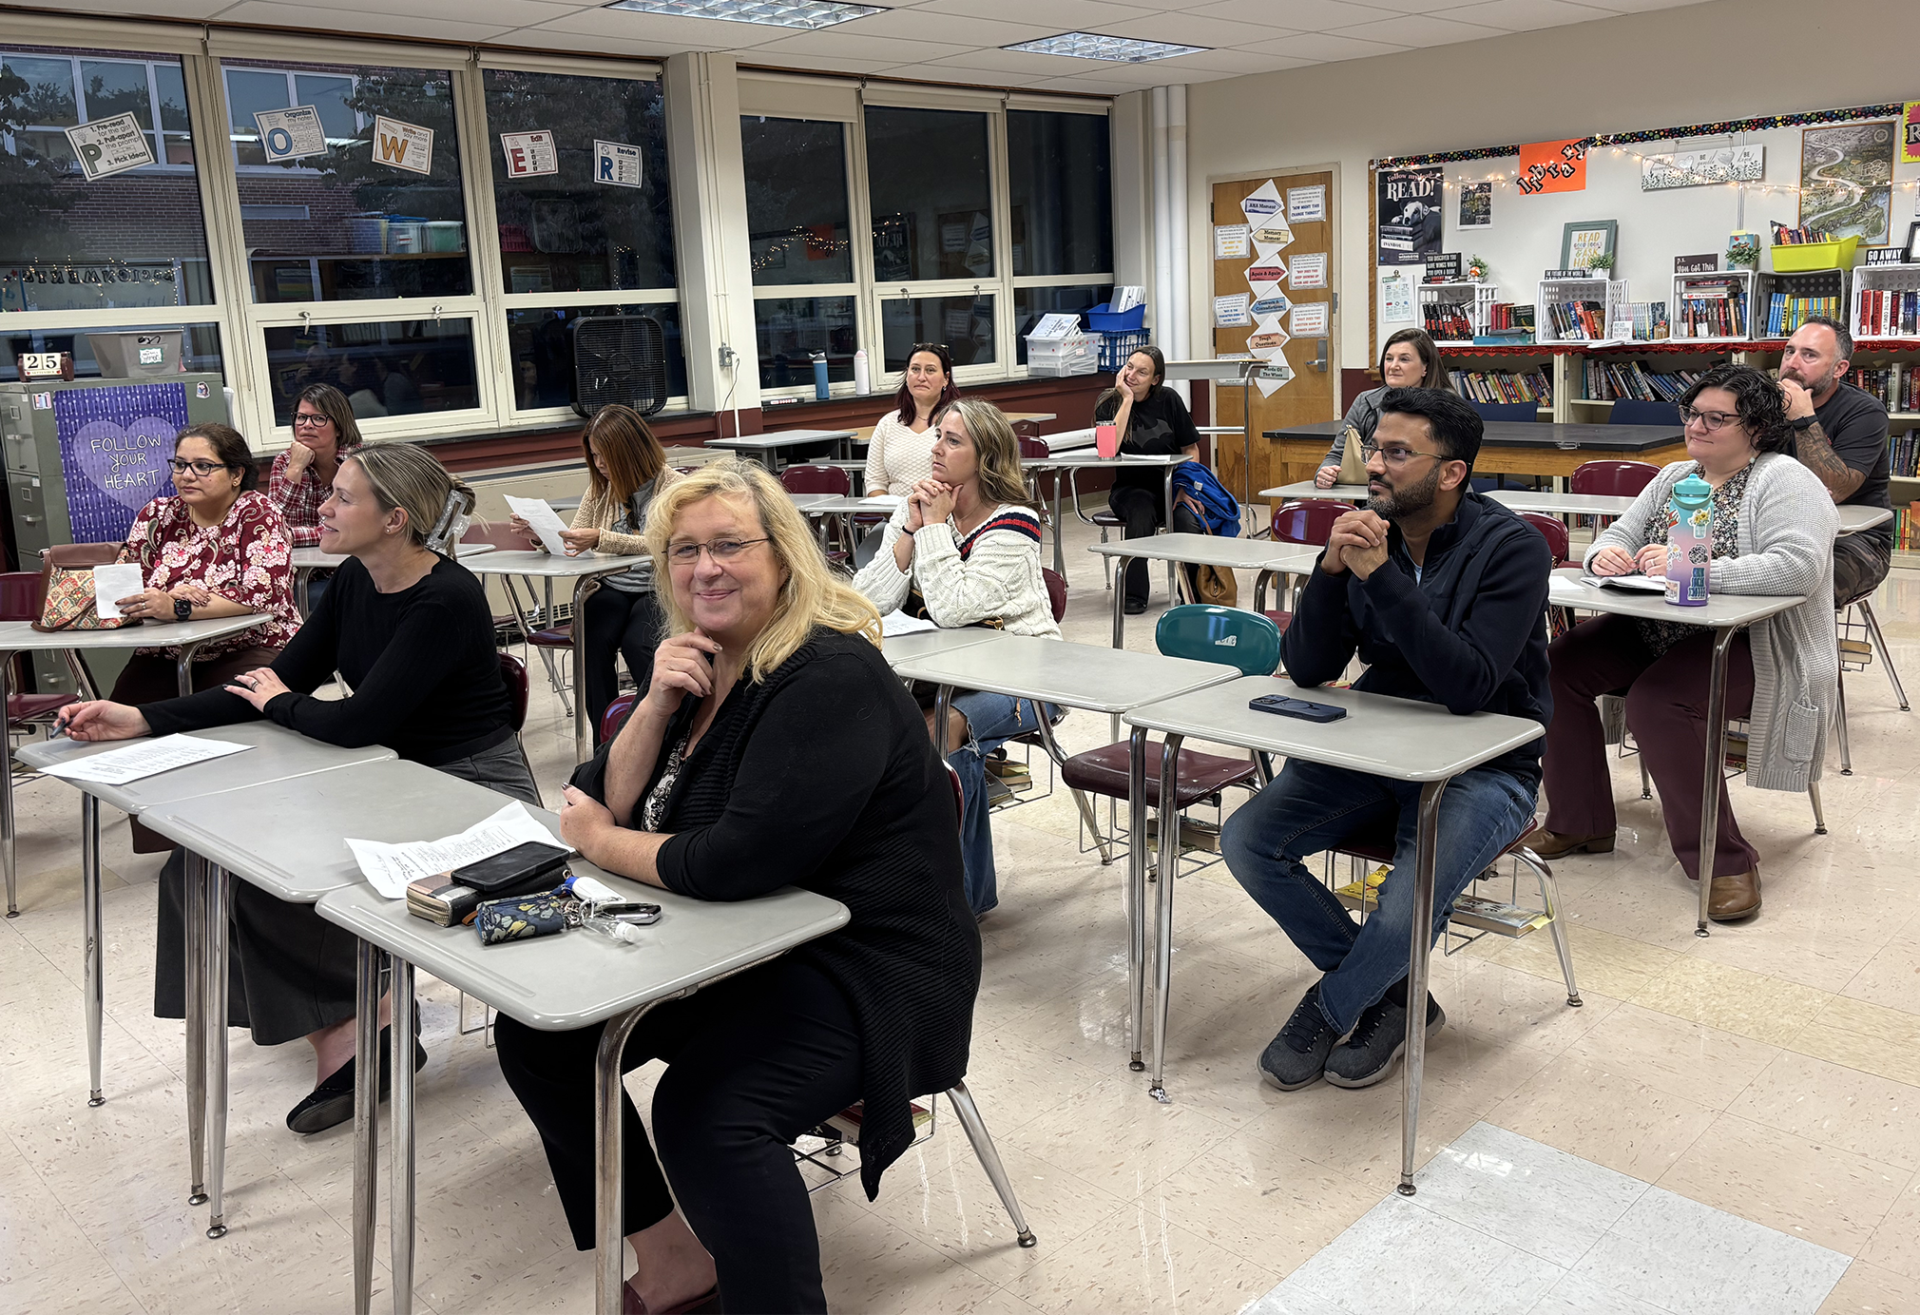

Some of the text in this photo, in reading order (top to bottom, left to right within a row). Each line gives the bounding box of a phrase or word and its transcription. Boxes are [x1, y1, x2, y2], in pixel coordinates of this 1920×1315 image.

[284, 110, 312, 118] Organize
[96, 119, 125, 130] Pre-read
[120, 124, 131, 132] gist
[104, 130, 136, 142] Pull-apart
[268, 128, 293, 156] O
[380, 132, 408, 164] W
[80, 144, 102, 174] P
[114, 156, 128, 164] Pick
[510, 148, 527, 172] E
[600, 156, 614, 180] R
[1387, 172, 1406, 182] Follow
[1386, 180, 1435, 202] READ!
[1578, 232, 1600, 242] READ
[1868, 249, 1902, 261] GO AWAY
[27, 355, 57, 369] 25
[90, 434, 161, 454] FOLLOW
[108, 453, 148, 473] YOUR
[104, 469, 159, 490] HEART
